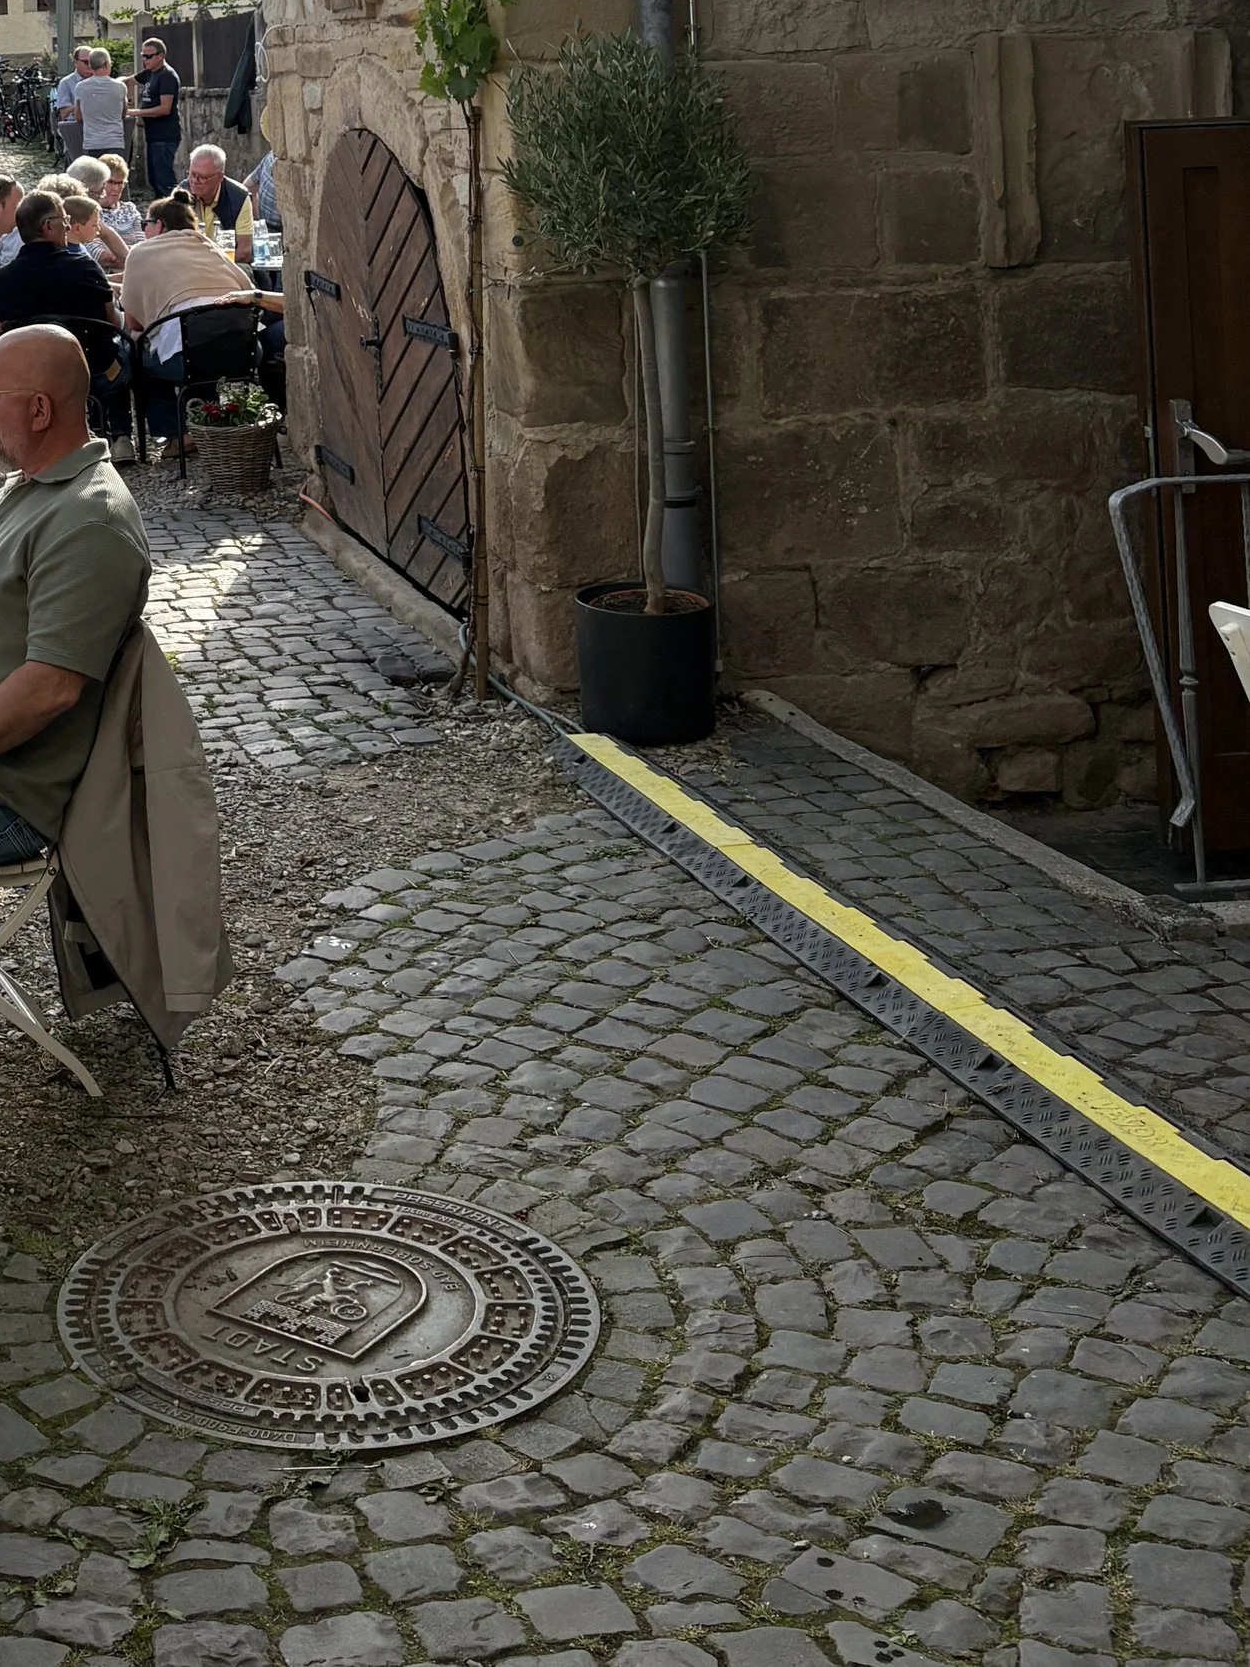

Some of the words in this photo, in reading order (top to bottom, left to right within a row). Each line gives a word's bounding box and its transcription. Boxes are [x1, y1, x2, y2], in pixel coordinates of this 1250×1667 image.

[393, 1191, 509, 1229] PASSAVANT
[304, 1238, 434, 1270] SOBERNHEIM
[432, 1270, 460, 1292] BAD
[201, 1325, 324, 1372] STADT
